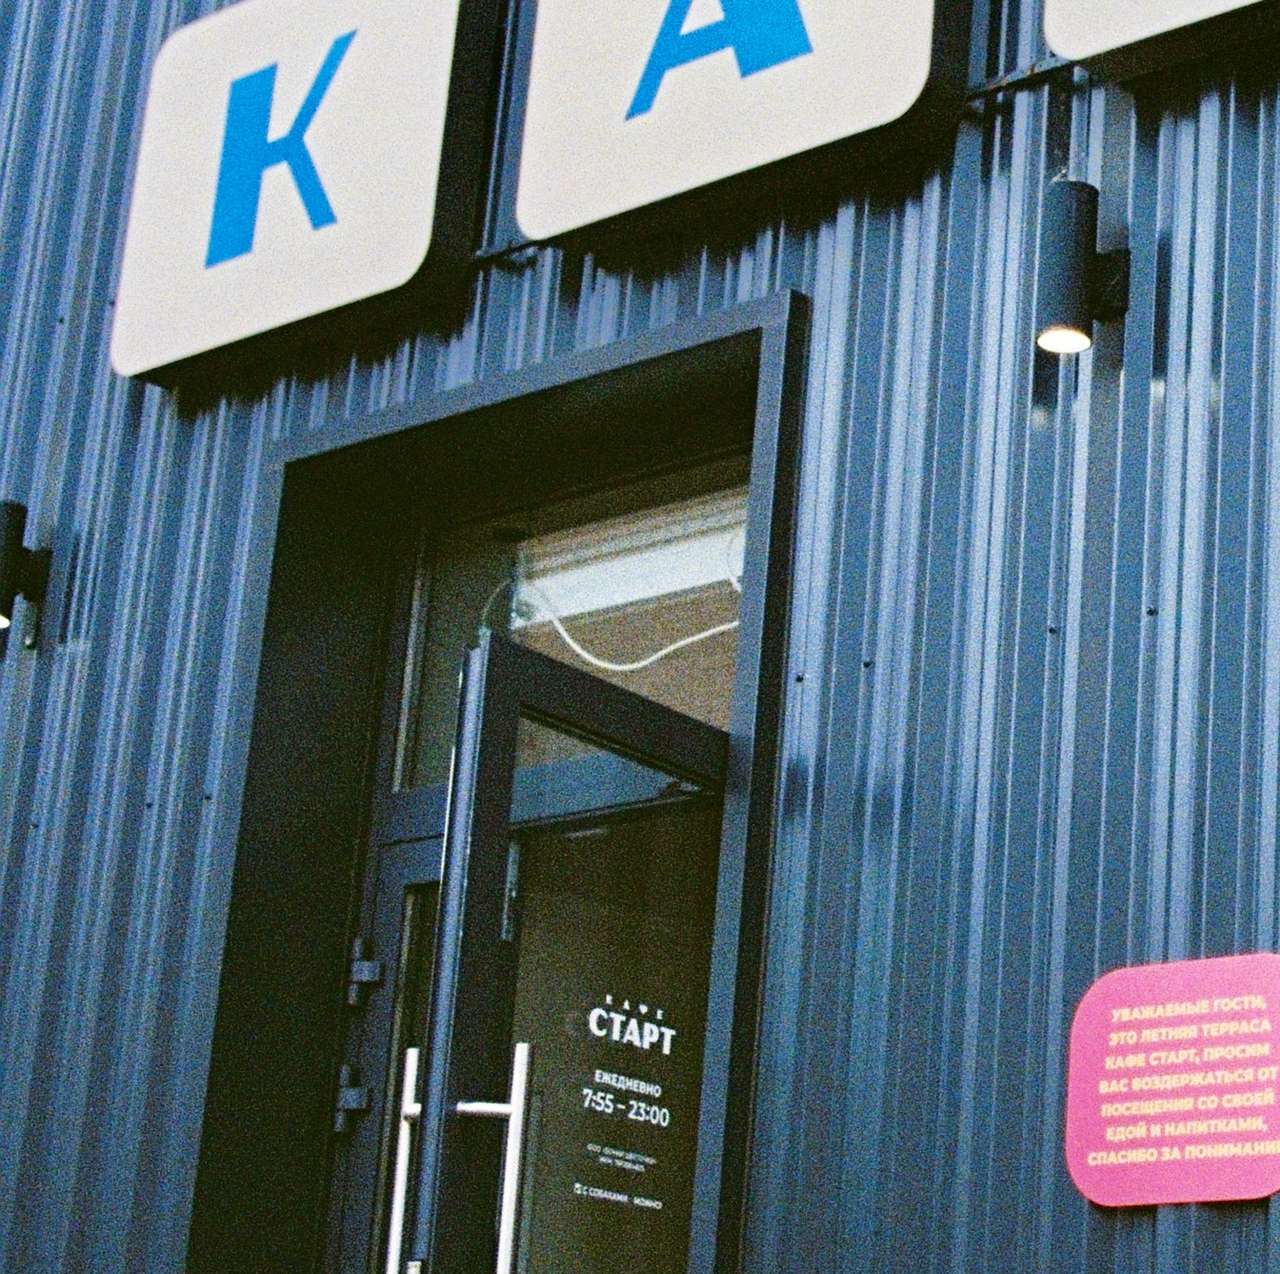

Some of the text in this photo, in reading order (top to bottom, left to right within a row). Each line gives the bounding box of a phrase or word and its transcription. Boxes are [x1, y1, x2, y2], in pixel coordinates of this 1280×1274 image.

[605, 994, 664, 1020] КАФЕ
[1112, 995, 1267, 1023] УВАЖАЕМЫЕ ГОСТИ,
[589, 1008, 677, 1055] СТАРТ
[1109, 1018, 1272, 1046] ЭТО ЛЕТНЯЯ ТЕРРАСА
[1105, 1042, 1270, 1069] КАФЕ СТАРТ, ПРОСИМ
[594, 1069, 662, 1098] ЕЖЕДНЕВНО
[1099, 1066, 1279, 1094] ВАС ВОЗДЕРЖАТЬСЯ ОТ
[582, 1088, 614, 1114] 7:55
[627, 1100, 670, 1127] 23:00
[1101, 1088, 1275, 1117] ПОСЕЩЕНИЯ СО СВОЕЙ
[1106, 1122, 1147, 1142] ЕДОЙ
[1150, 1123, 1161, 1137] И
[1087, 1148, 1158, 1166] СПАСИБО
[1160, 1146, 1181, 1161] ЗА
